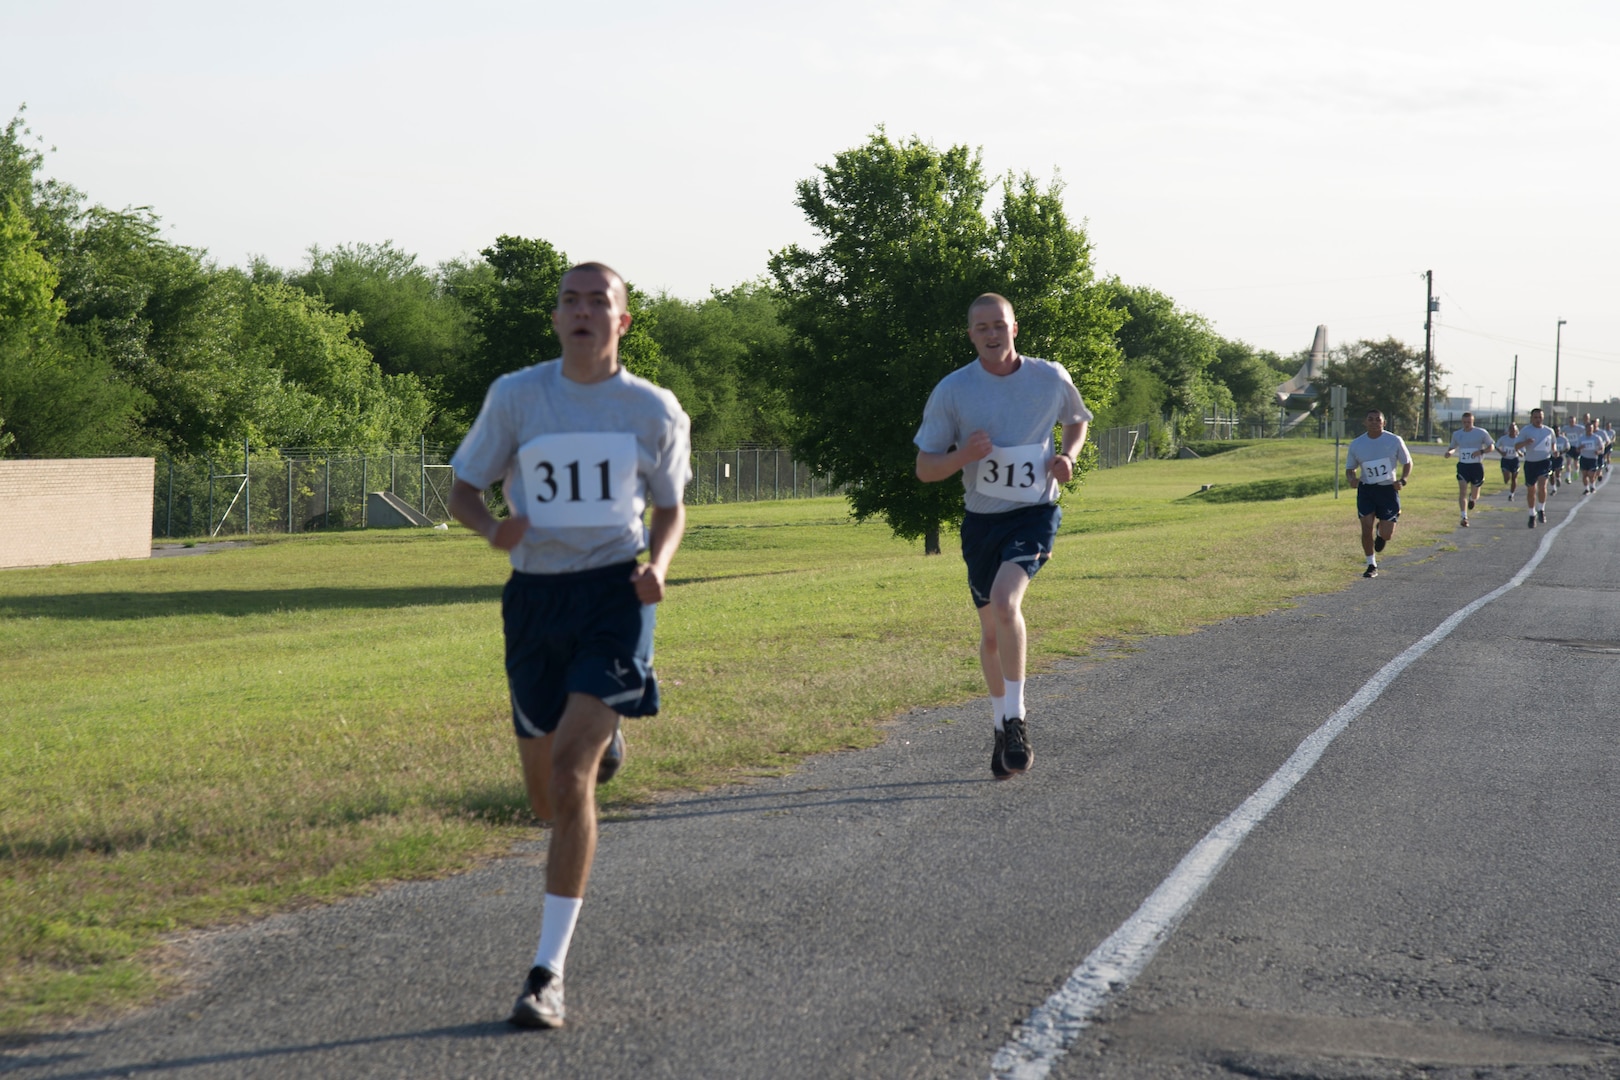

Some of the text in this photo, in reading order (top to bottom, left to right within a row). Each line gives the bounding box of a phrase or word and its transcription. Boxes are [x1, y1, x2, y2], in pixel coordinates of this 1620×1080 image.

[534, 459, 616, 503] 311
[983, 459, 1036, 489] 313
[1366, 464, 1388, 478] 312
